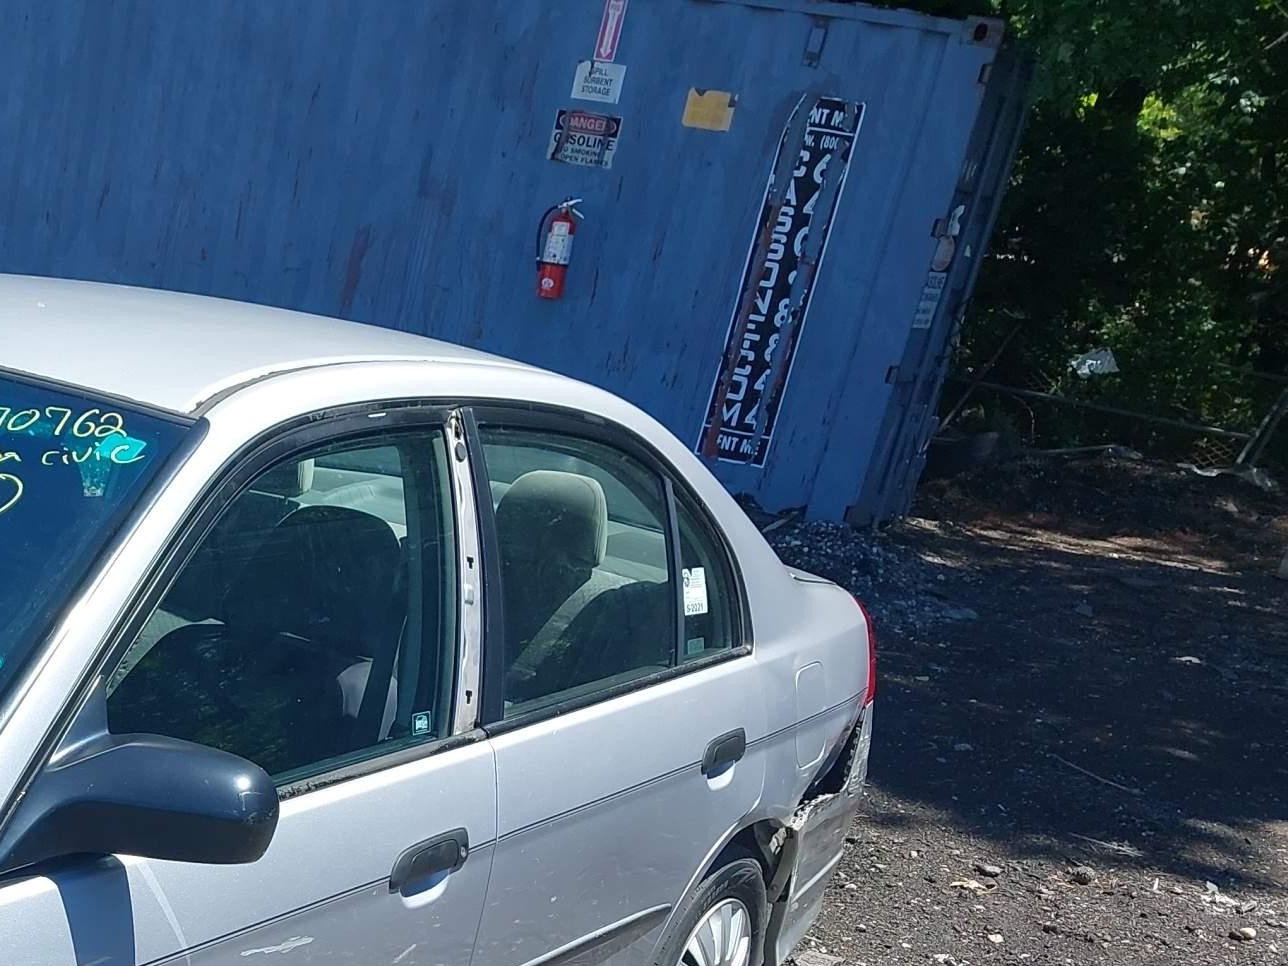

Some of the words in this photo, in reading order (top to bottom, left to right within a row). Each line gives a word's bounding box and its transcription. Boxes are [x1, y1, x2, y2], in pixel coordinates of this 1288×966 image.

[581, 84, 612, 96] STORAGE
[570, 115, 608, 131] ANGE
[554, 131, 616, 152] GSOLINE
